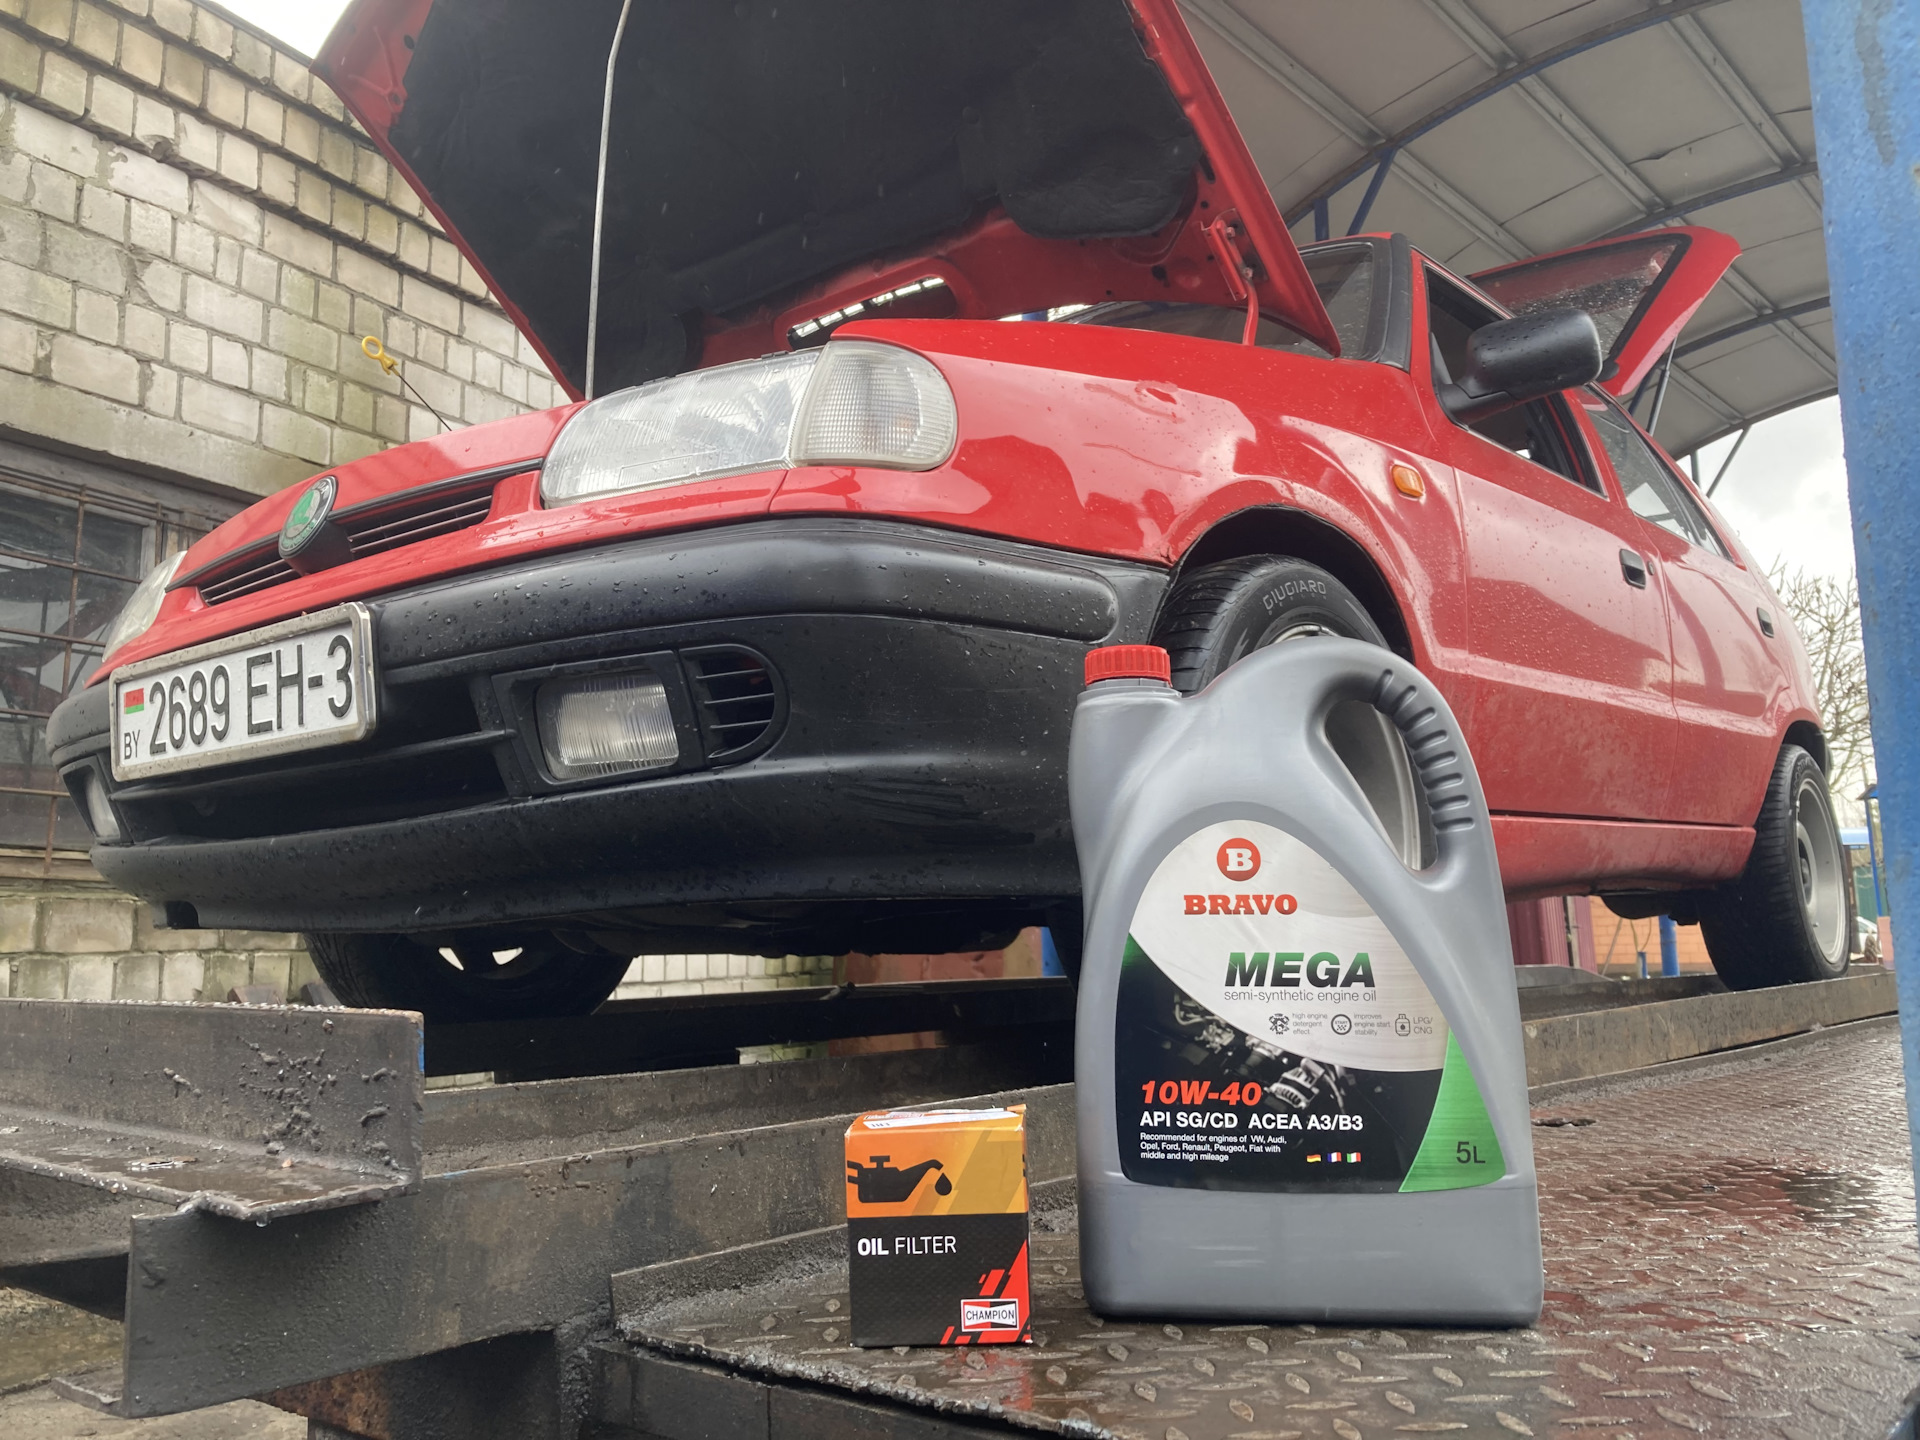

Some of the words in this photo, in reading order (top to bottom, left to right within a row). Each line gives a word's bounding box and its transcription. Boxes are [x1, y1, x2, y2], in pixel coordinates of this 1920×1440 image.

[1262, 579, 1327, 610] GIUGIARO
[149, 664, 231, 756] 2689
[246, 634, 353, 736] EH-3
[124, 730, 141, 760] BY
[1226, 848, 1254, 871] B
[1183, 894, 1298, 915] BRAVO
[1225, 951, 1376, 988] MEGA
[1224, 989, 1314, 1003] semi-synthetic
[1317, 990, 1359, 1004] engine
[1363, 990, 1377, 1001] oil
[1292, 1012, 1306, 1020] high
[1413, 1016, 1433, 1025] LPG/
[1141, 1080, 1262, 1106] 10W-40
[1140, 1111, 1171, 1127] API
[1176, 1112, 1238, 1129] SG/CD
[1248, 1113, 1303, 1130] ACEA
[1307, 1114, 1364, 1131] A3/B3
[1140, 1132, 1196, 1142] Recommended
[1197, 1133, 1207, 1142] for
[1208, 1134, 1238, 1144] engines
[1239, 1135, 1247, 1143] of
[1250, 1135, 1266, 1144] VW,
[1267, 1136, 1288, 1145] Audi,
[1140, 1142, 1160, 1151] Opel,
[1161, 1142, 1181, 1152] Ford,
[1182, 1143, 1213, 1153] Renault,
[1214, 1144, 1248, 1154] Peugeot,
[1249, 1144, 1263, 1153] Fiat
[1264, 1145, 1281, 1153] with
[1140, 1151, 1165, 1160] middle
[1166, 1152, 1181, 1160] and
[1182, 1152, 1199, 1162] high
[1200, 1152, 1229, 1163] mileage
[1456, 1141, 1486, 1164] 5L
[857, 1237, 889, 1256] OIL
[895, 1235, 957, 1255] FILTER
[965, 1309, 1015, 1321] CHAMPION
